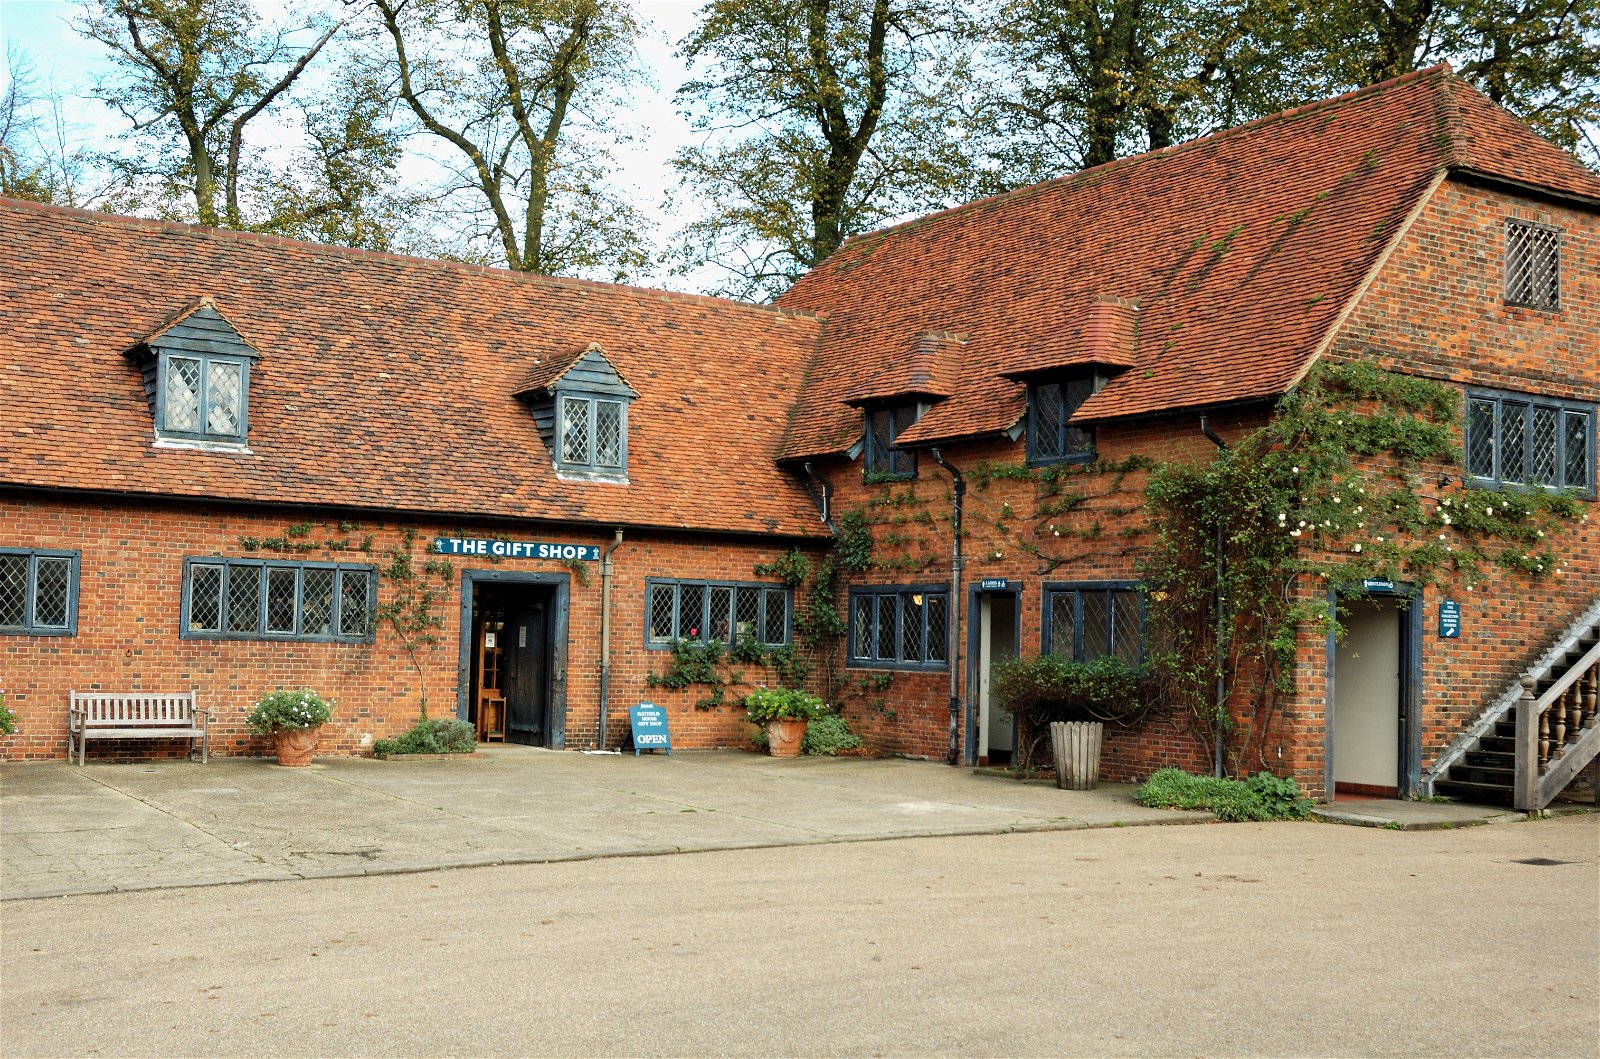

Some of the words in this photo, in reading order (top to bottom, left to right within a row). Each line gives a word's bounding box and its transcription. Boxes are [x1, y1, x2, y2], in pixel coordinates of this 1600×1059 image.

[450, 539, 487, 554] THE
[492, 541, 534, 557] GIFT
[539, 544, 587, 559] SHOP
[638, 734, 667, 744] OPEN
